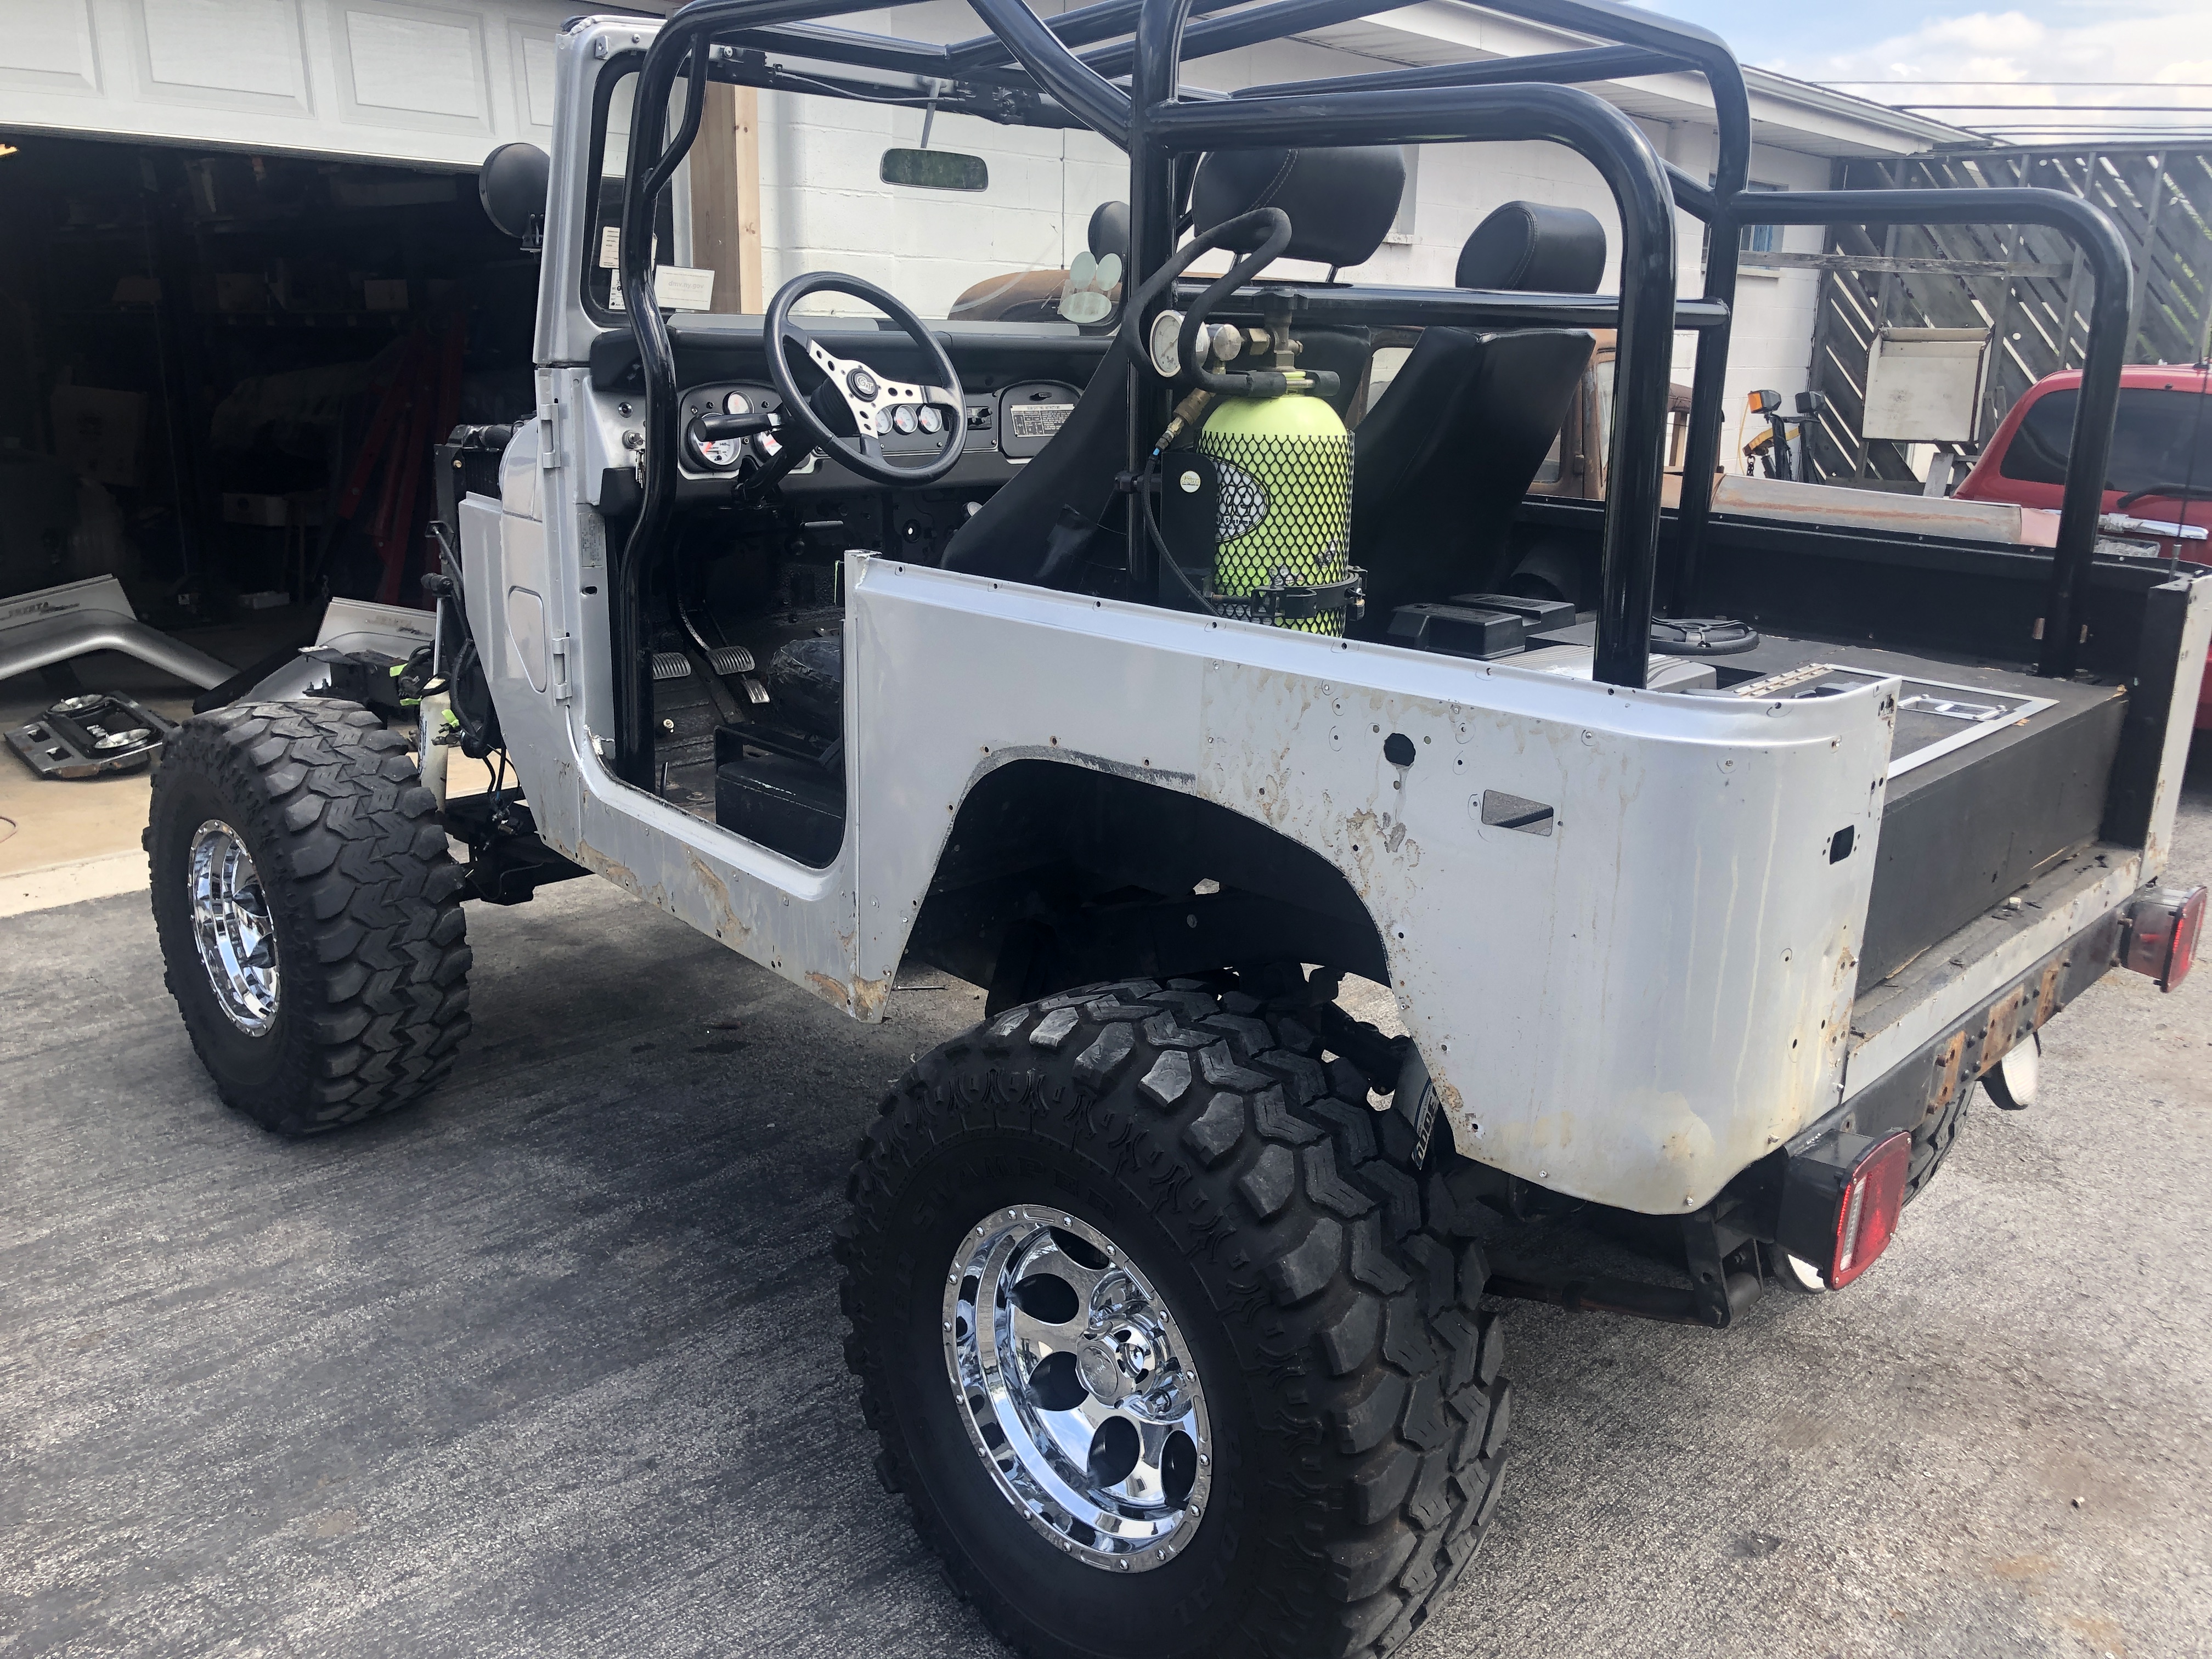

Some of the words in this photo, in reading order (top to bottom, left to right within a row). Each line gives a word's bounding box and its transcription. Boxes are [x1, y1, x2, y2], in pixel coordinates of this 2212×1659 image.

[668, 280, 704, 289] dmv.ny.gov
[856, 376, 874, 392] GT
[1181, 476, 1200, 484] Source
[909, 1152, 1117, 1235] SWAMPER
